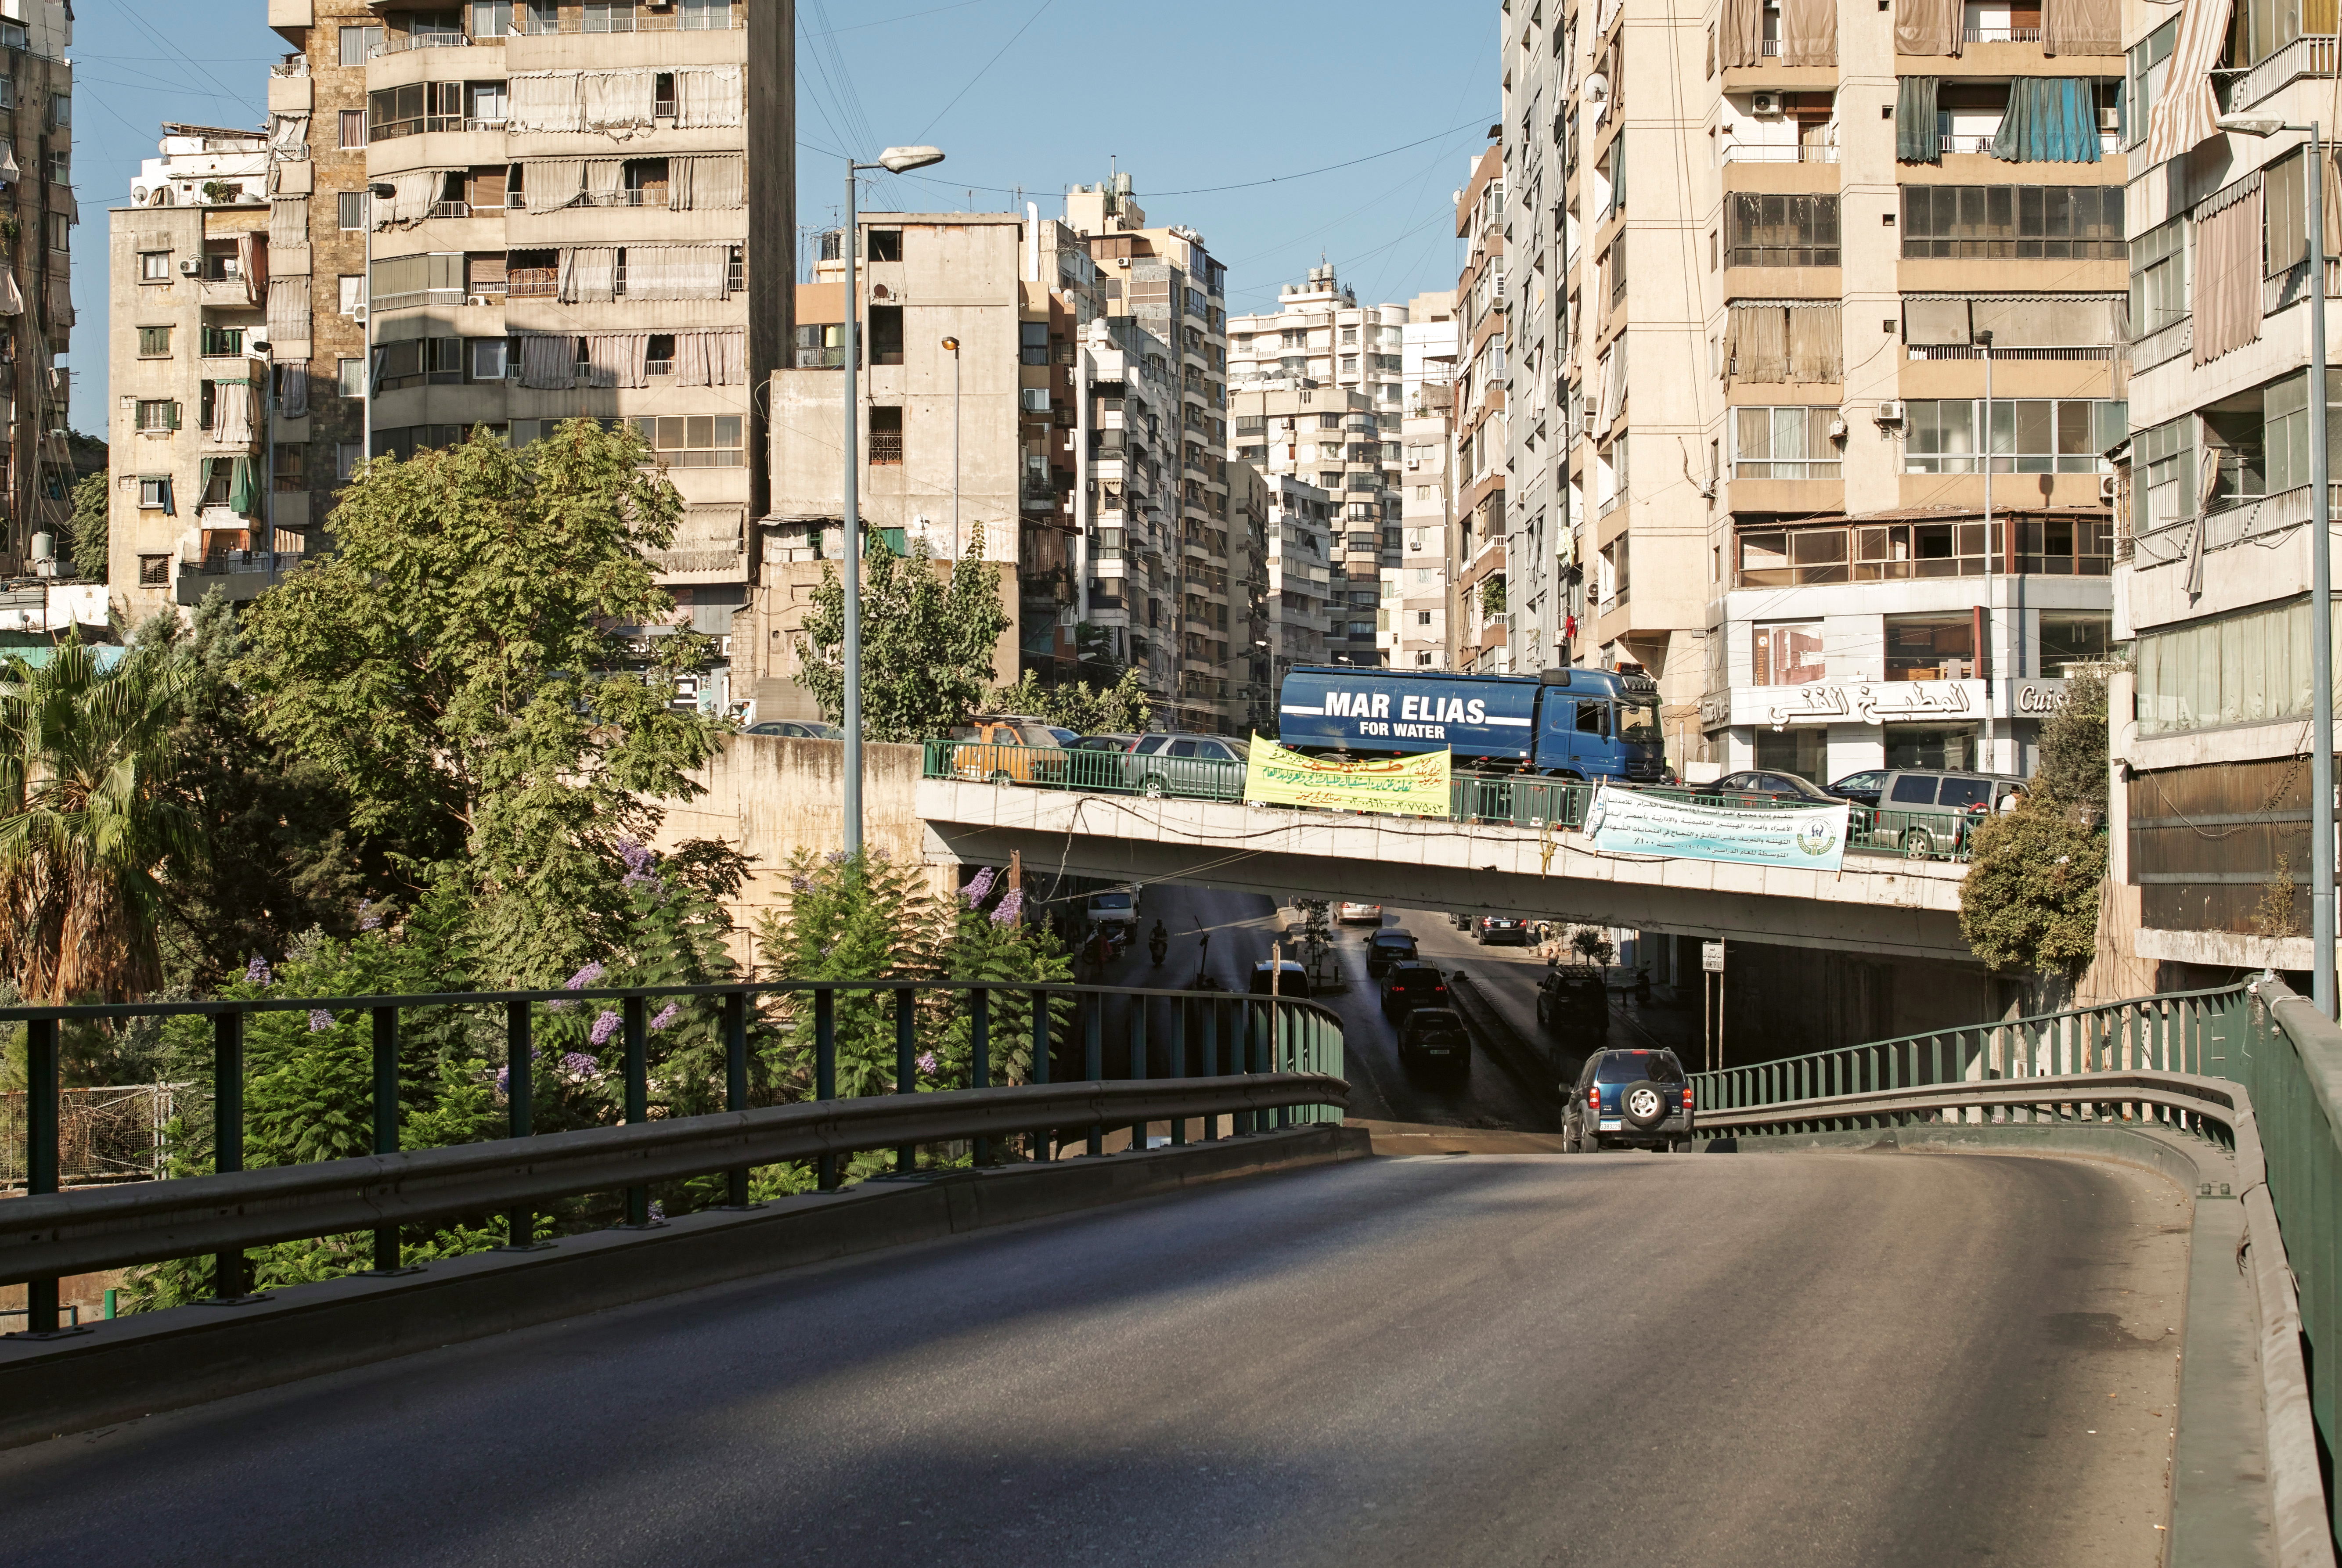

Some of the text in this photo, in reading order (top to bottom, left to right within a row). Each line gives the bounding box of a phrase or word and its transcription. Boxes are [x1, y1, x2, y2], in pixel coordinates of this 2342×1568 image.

[1325, 691, 1486, 724] MAR ELIAS
[1768, 687, 1849, 732] الفني
[1856, 683, 1970, 726] المطبخ
[1360, 721, 1445, 739] FOR WATER
[1262, 766, 1277, 780] العام
[1415, 765, 1428, 775] مكة
[1316, 774, 1340, 786] طلبات
[1382, 779, 1394, 790] عن
[1393, 779, 1412, 791] تعلن
[1296, 791, 1342, 803] برنامج حج مميز
[1624, 812, 1648, 821] بأسمى
[1716, 821, 1745, 829] الهيئتين
[1747, 823, 1767, 831] وأفراد
[1663, 828, 1670, 838] في
[1657, 841, 1675, 850] بنسبة
